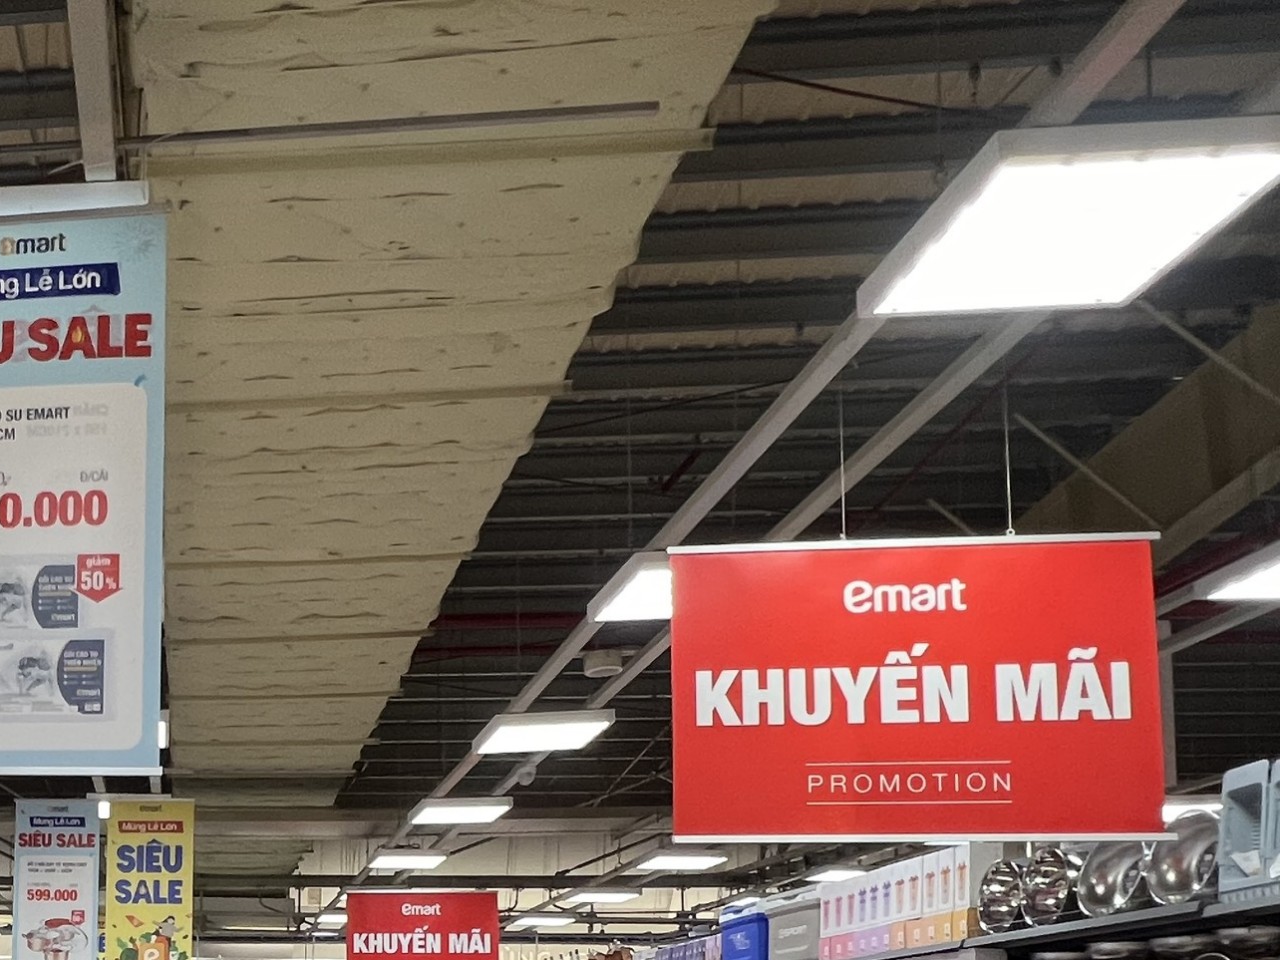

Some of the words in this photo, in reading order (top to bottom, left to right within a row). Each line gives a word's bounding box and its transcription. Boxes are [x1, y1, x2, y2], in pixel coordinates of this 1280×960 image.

[25, 268, 53, 292] Lễ
[59, 268, 101, 290] Lớn
[27, 313, 152, 362] SALE
[6, 409, 22, 422] SU
[26, 406, 71, 422] EMART
[843, 577, 967, 614] emart
[694, 643, 970, 728] KHUYẾN
[994, 646, 1132, 722] MÃI
[807, 771, 1013, 795] PROMOTION
[18, 830, 52, 849] SIÊU
[56, 833, 96, 848] SALE
[116, 838, 183, 874] SIÊU
[27, 888, 78, 901] 599.000
[114, 879, 183, 905] SALE
[401, 903, 441, 916] emart
[353, 925, 441, 954] KHUYẾN
[448, 928, 492, 954] MÃI
